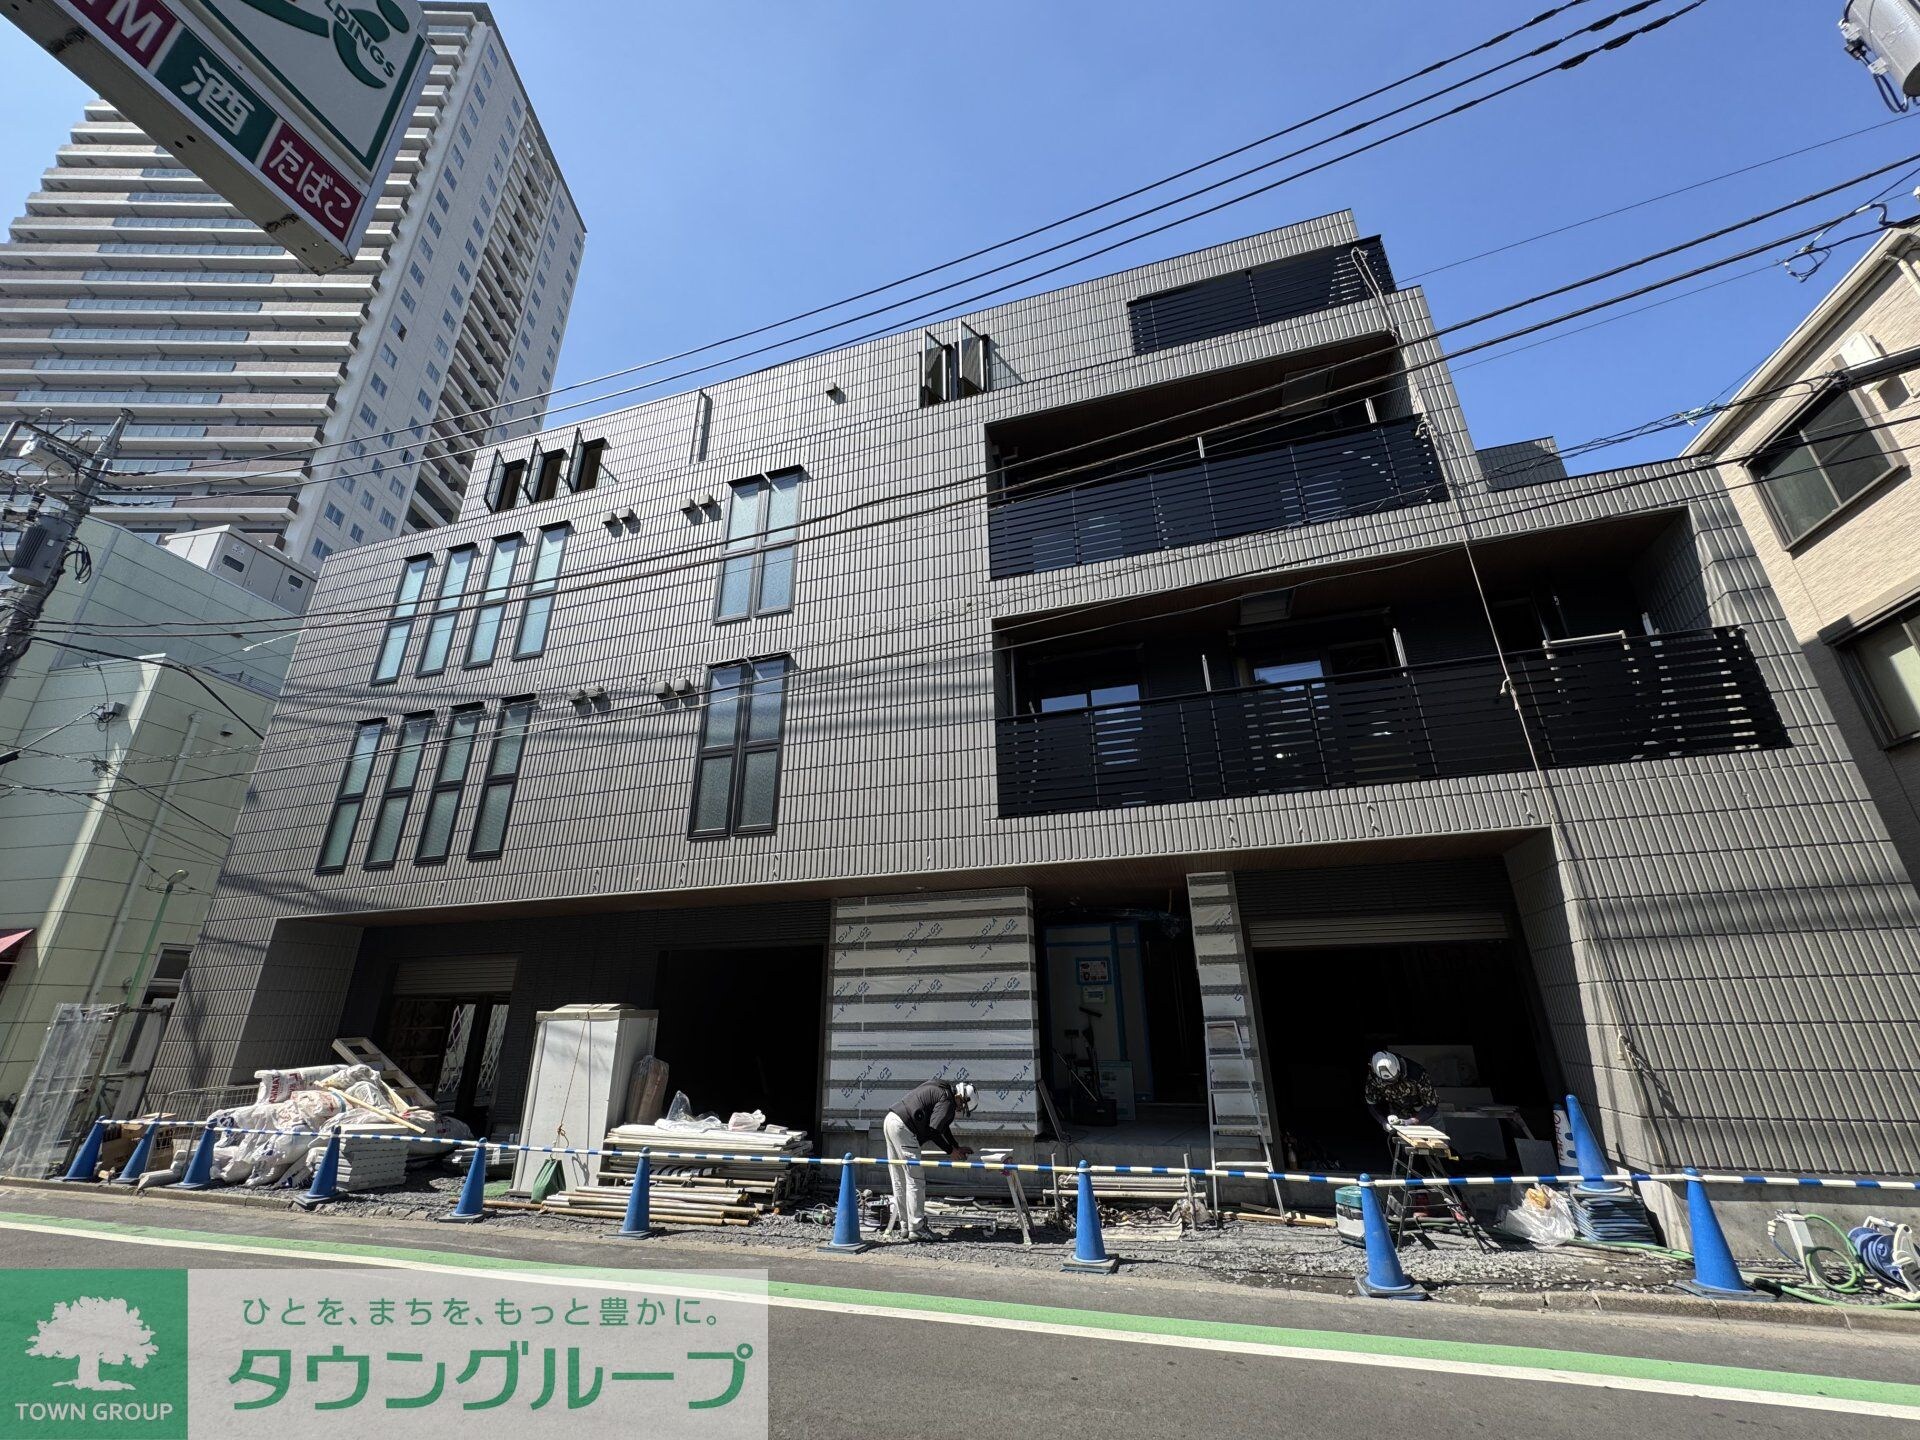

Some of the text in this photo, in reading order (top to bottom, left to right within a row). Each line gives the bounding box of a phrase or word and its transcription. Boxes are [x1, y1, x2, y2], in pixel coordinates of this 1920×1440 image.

[86, 0, 163, 53] M
[180, 56, 256, 136] 酒
[269, 139, 352, 229] たばこ
